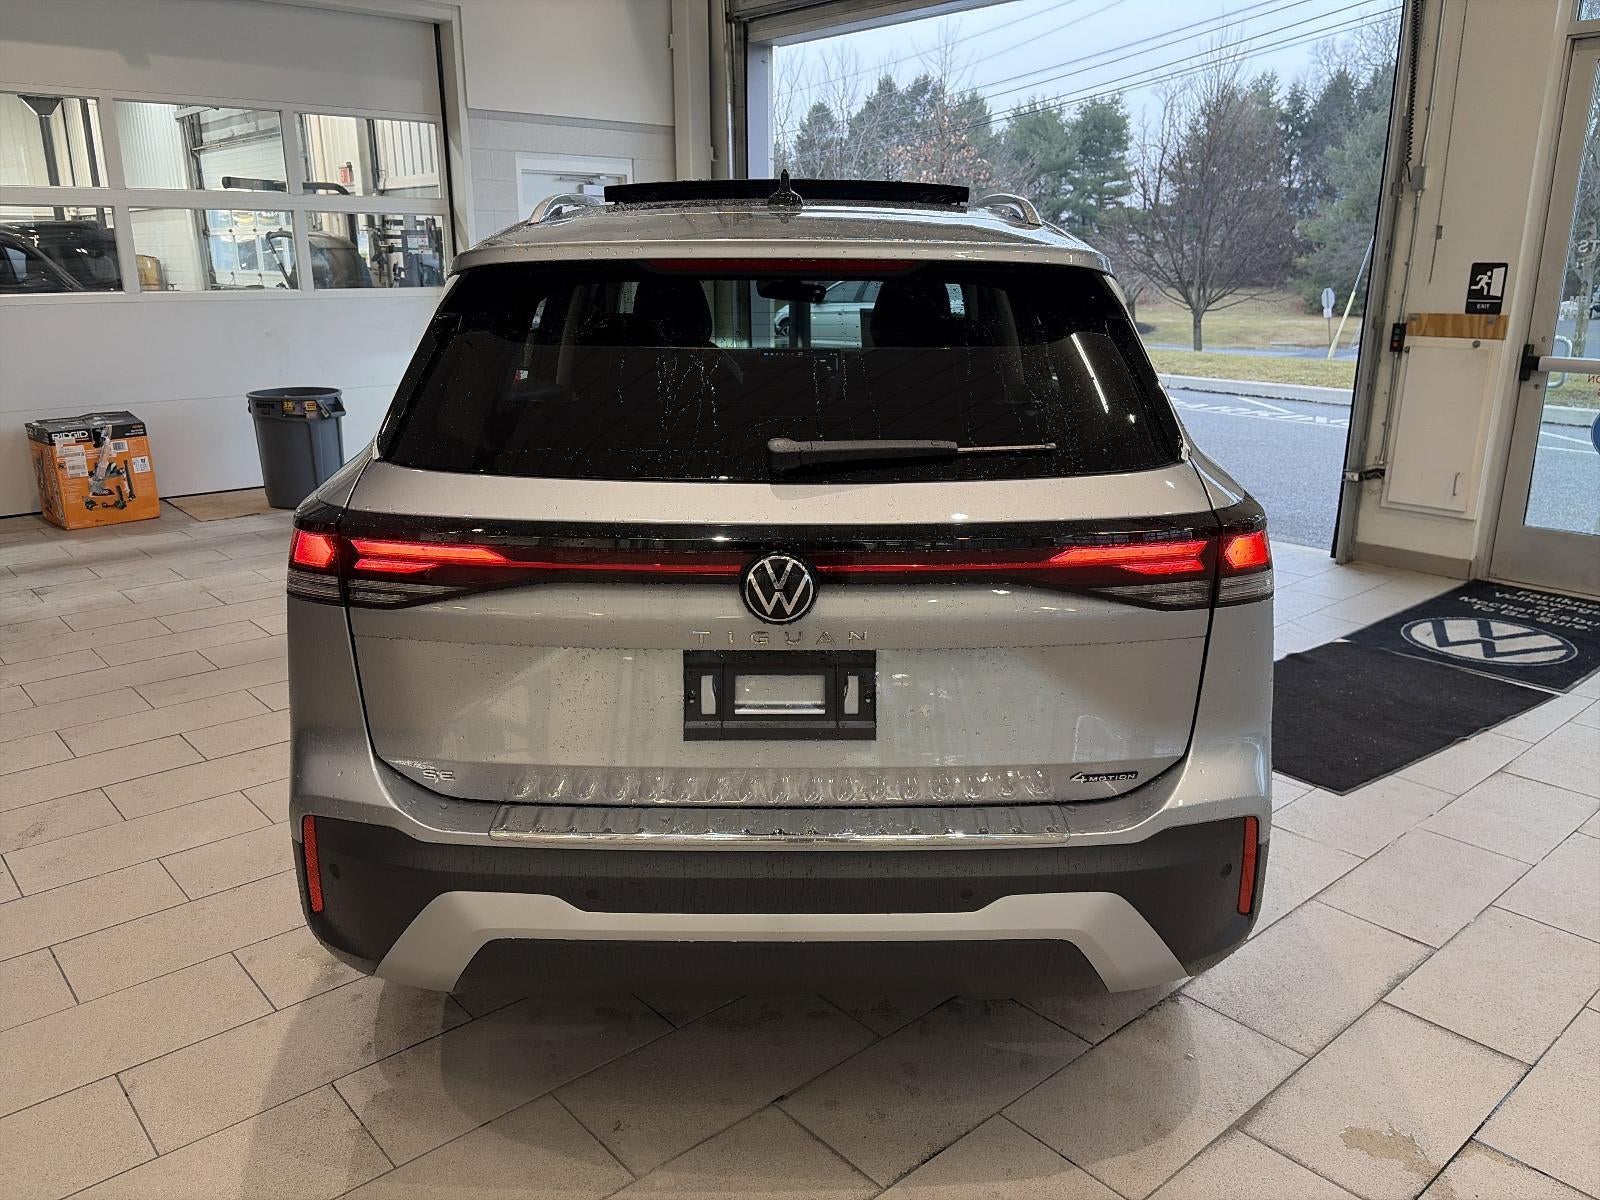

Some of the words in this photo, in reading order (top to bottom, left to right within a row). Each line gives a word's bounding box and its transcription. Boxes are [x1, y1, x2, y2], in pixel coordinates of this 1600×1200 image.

[51, 430, 89, 441] RIDGID
[692, 630, 868, 645] TIGUAN
[423, 768, 455, 781] SE
[1069, 770, 1138, 784] 4MOTION
